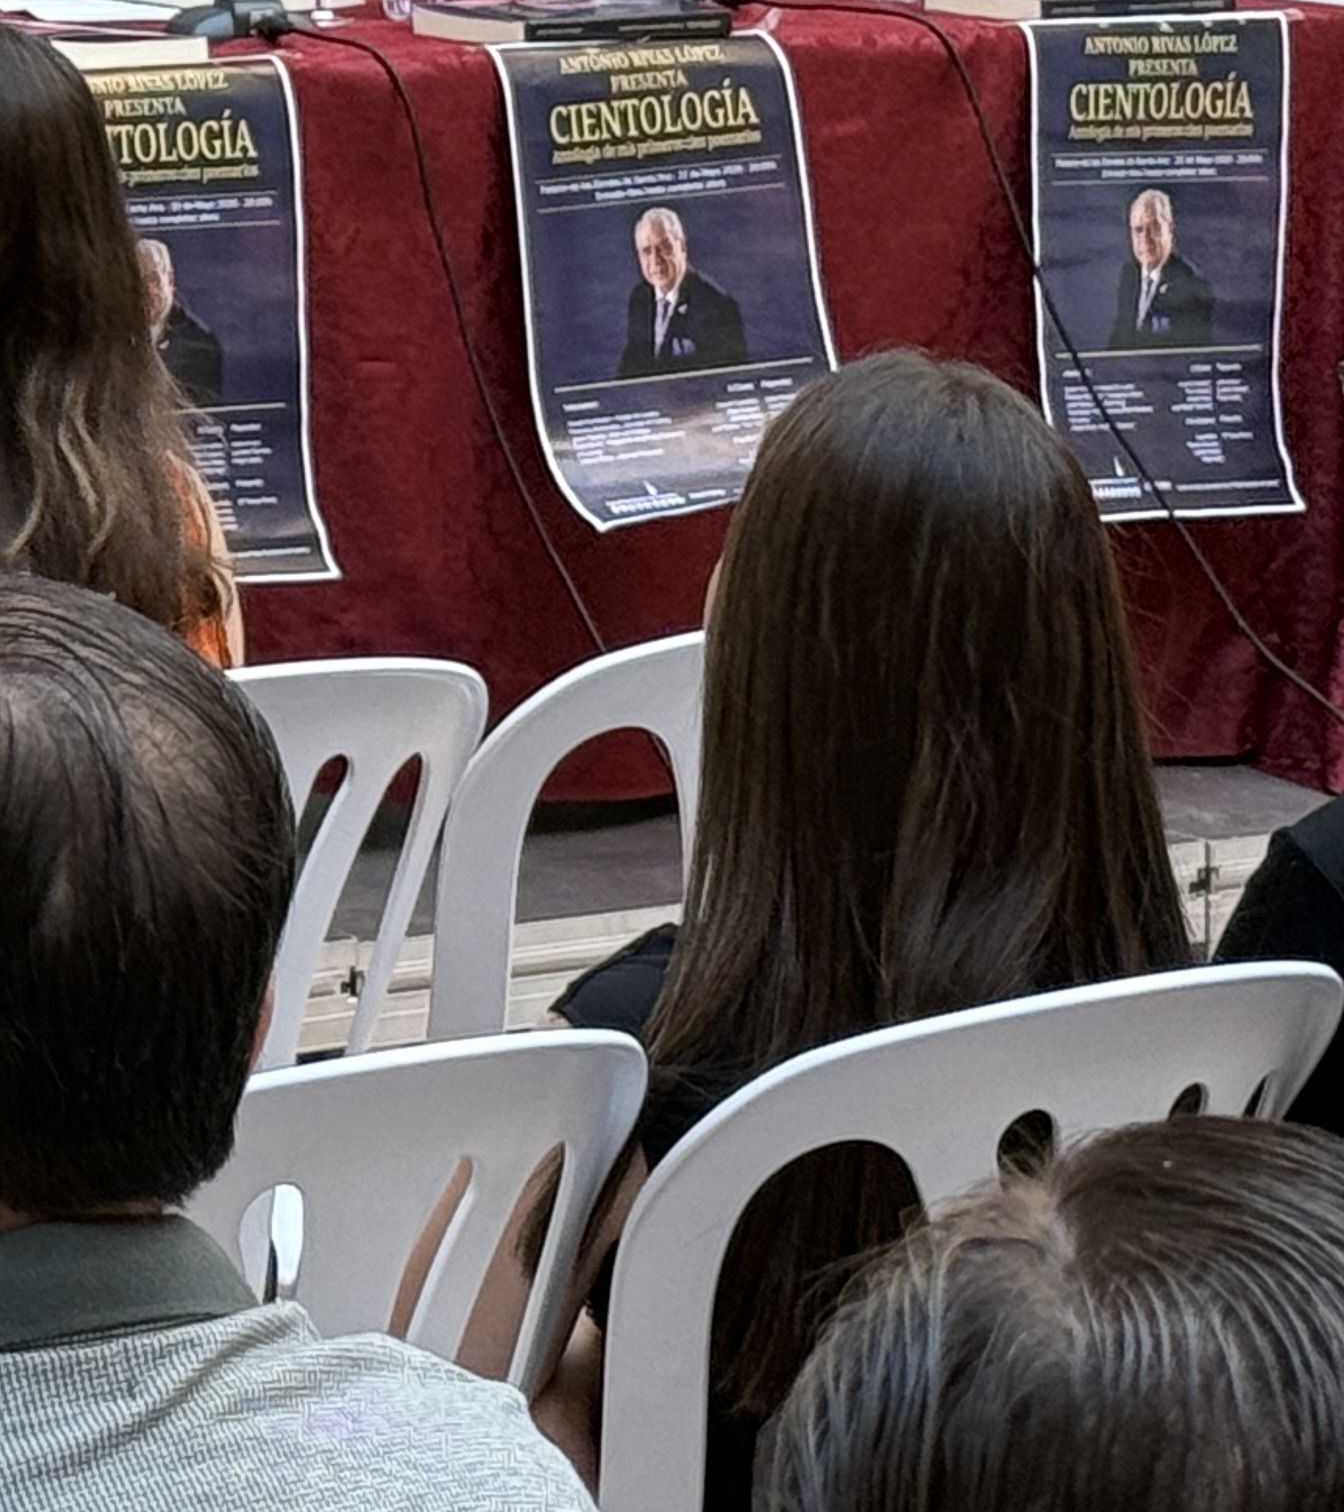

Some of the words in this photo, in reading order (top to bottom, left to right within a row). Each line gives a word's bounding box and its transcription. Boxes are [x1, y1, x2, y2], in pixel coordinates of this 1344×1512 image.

[1084, 35, 1150, 55] ANTONIO
[1152, 34, 1192, 54] RIVAS
[1194, 31, 1238, 54] LÓPEZ
[559, 51, 630, 75] ANTONIO
[676, 43, 726, 65] LÓPEZ
[1128, 58, 1199, 76] PRESENTA
[610, 69, 690, 94] PRESENTA
[104, 96, 187, 120] PRESENTA
[1070, 71, 1254, 122] CIENTOLOGÍA
[549, 77, 761, 145] CIENTOLOGÍA
